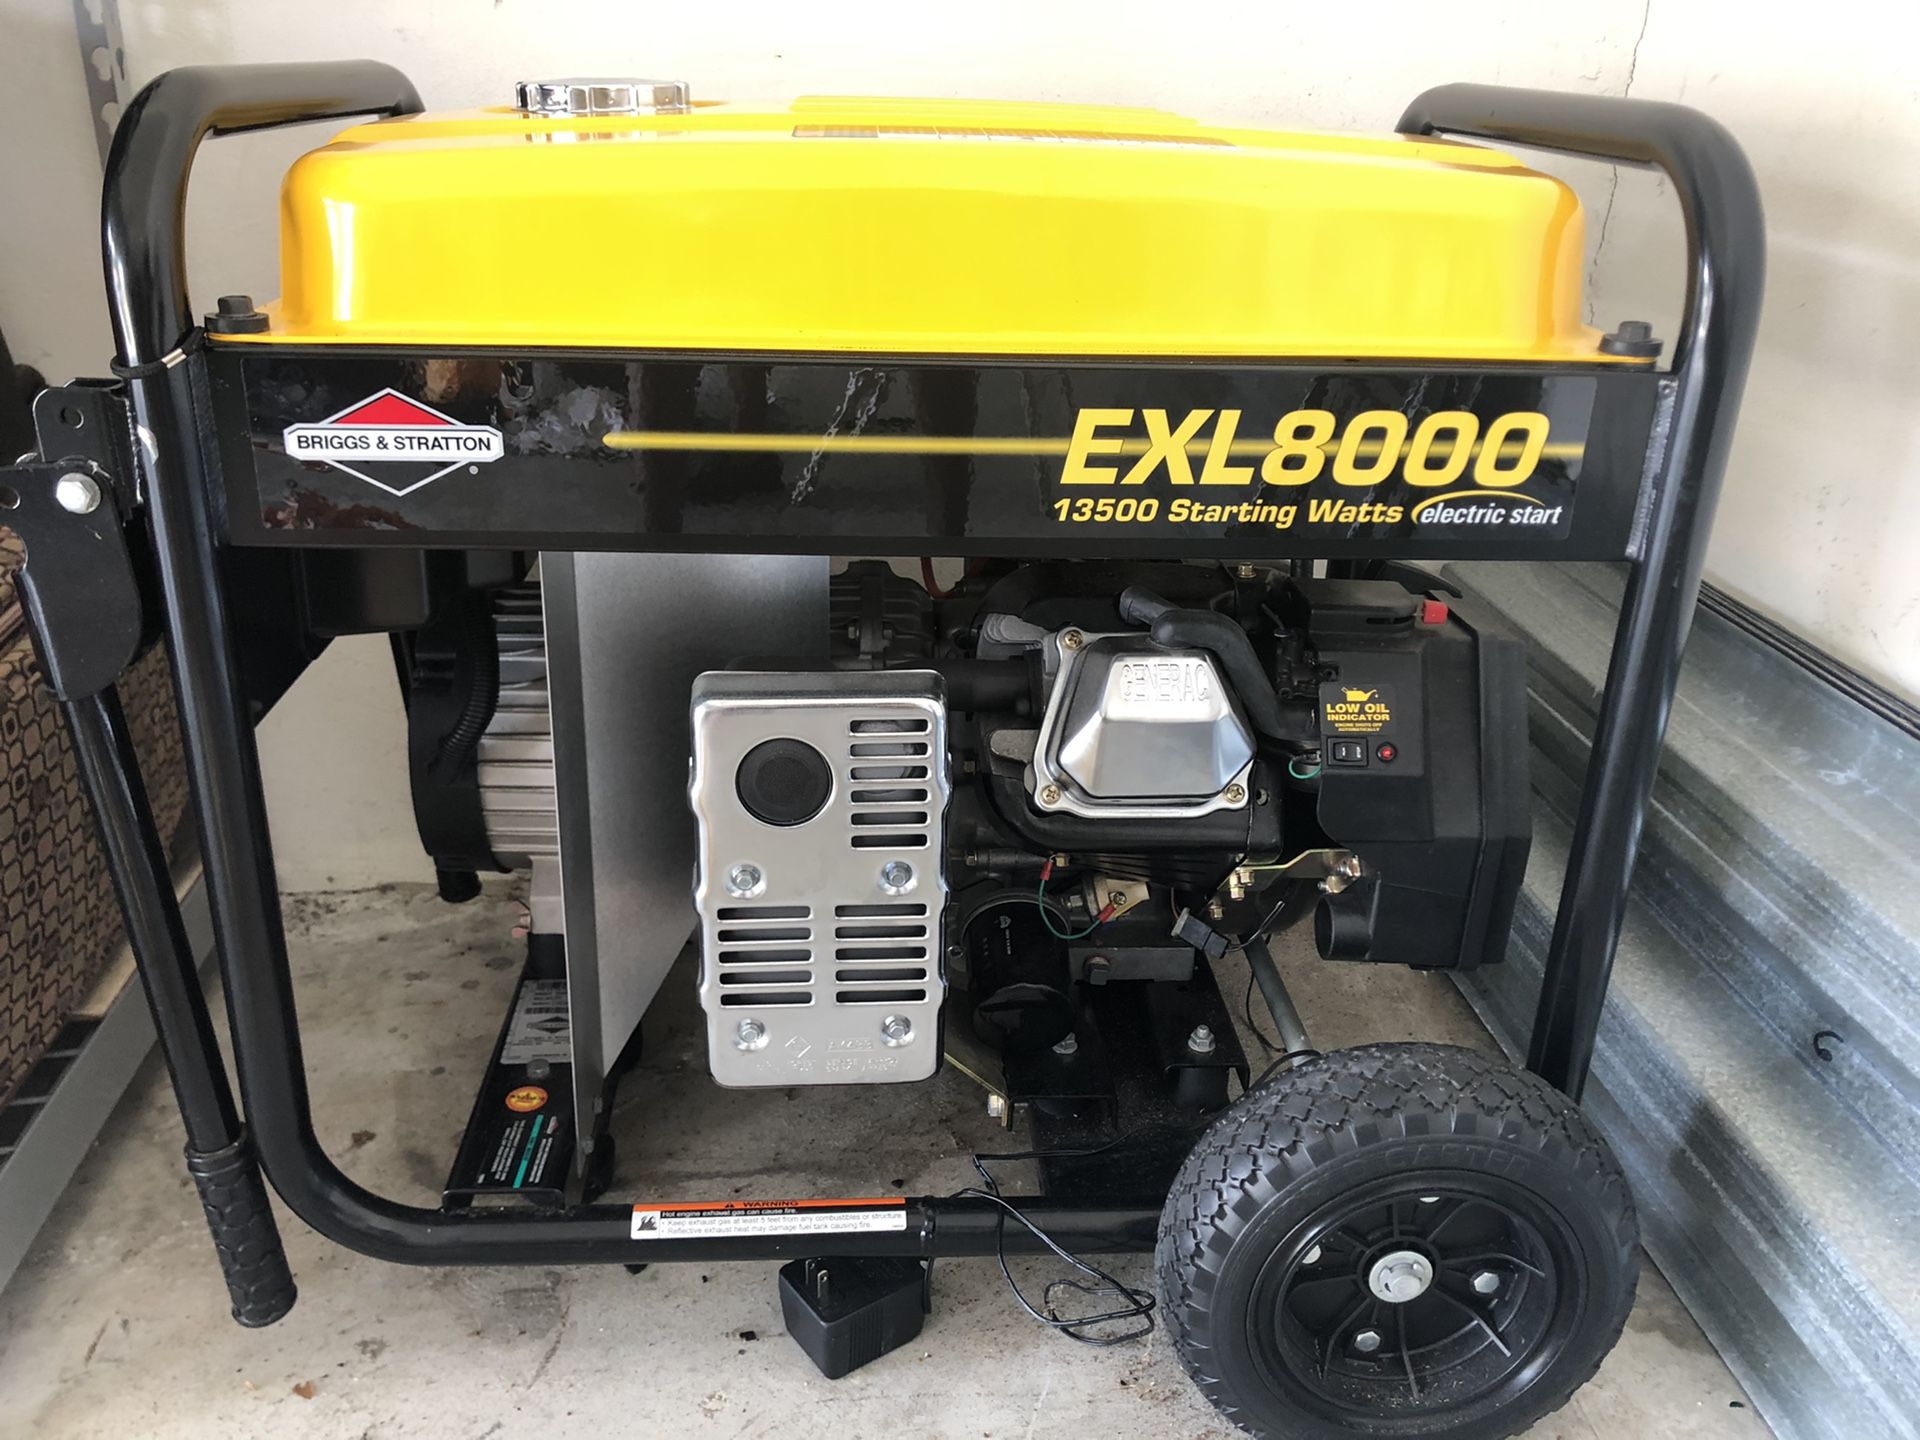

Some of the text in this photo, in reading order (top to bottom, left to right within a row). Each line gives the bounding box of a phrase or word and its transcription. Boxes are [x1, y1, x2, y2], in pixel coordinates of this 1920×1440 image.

[297, 435, 491, 451] BRIGGS & STRATTON
[1059, 407, 1551, 487] EXL8000
[1053, 498, 1404, 529] 13500 Starting Watts
[1420, 502, 1563, 525] electric start
[1120, 663, 1209, 702] GENERAC
[1326, 703, 1390, 713] LOW OIL
[676, 1210, 701, 1219] engine
[731, 1209, 745, 1217] gas
[746, 1208, 760, 1216] can
[743, 1200, 798, 1208] WARNING
